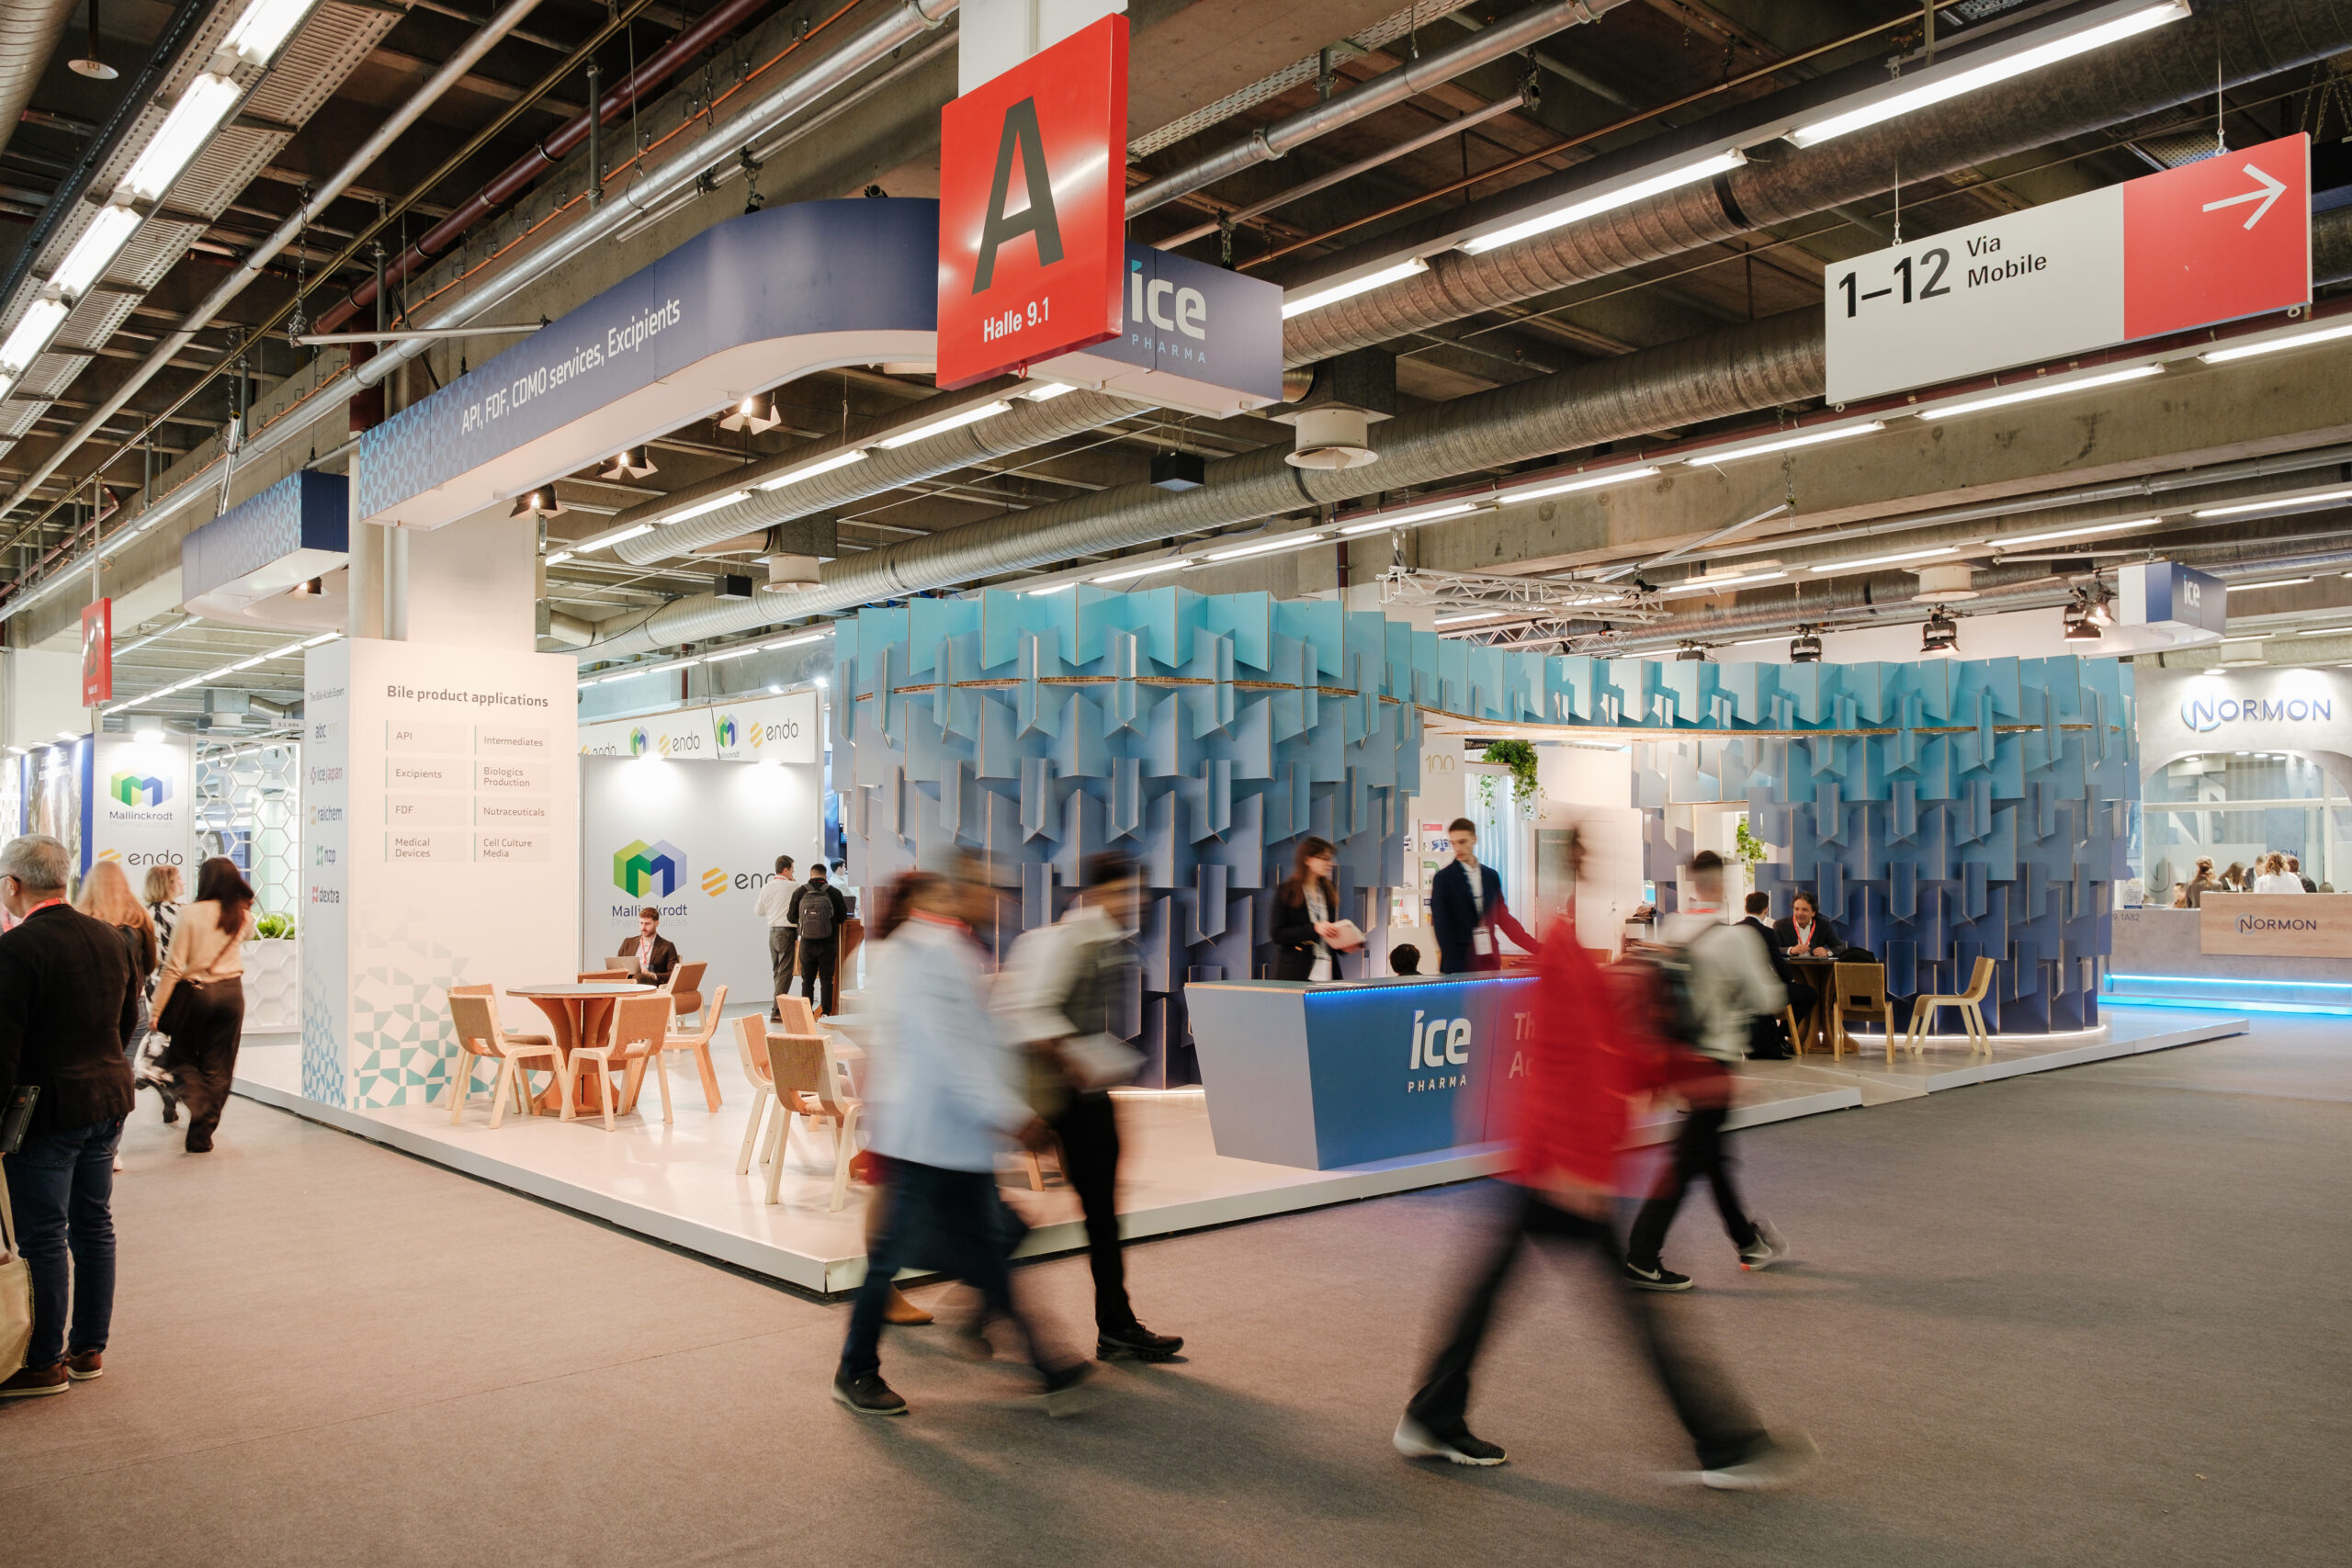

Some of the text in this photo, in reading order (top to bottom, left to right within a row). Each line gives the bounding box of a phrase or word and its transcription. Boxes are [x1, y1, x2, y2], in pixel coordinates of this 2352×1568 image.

[971, 95, 1065, 295] A
[1966, 235, 2002, 257] Via
[1968, 254, 2047, 288] Mobile
[1131, 259, 1206, 341] ice
[983, 296, 1049, 343] Halle 9.1
[1131, 333, 1206, 364] PHARMA
[461, 298, 681, 435] API, FDF, CDMO services, Excipients
[2183, 573, 2200, 608] ice
[387, 685, 548, 707] Bile product applications
[2192, 694, 2332, 731] NORMON
[396, 731, 413, 740] API
[765, 718, 799, 741] endo
[483, 736, 544, 747] Intermediates
[672, 730, 701, 751] endo
[395, 768, 443, 779] Excipients
[483, 766, 525, 778] Biologics
[483, 777, 530, 787] Production
[109, 811, 174, 820] Mallinckrodt
[317, 806, 343, 822] raichem
[395, 805, 414, 815] FDF
[483, 807, 545, 817] Nutraceuticals
[395, 837, 430, 847] Medical
[483, 838, 533, 847] Cell Culture
[128, 849, 184, 865] endo
[324, 848, 336, 865] nzp
[395, 849, 431, 858] Devices
[483, 849, 509, 858] Media
[735, 873, 776, 889] en
[319, 886, 340, 903] dextra
[612, 904, 688, 918] Mallikrodt
[2239, 914, 2317, 933] NORMON
[1409, 1010, 1472, 1070] ice
[1408, 1074, 1467, 1093] PHARMA
